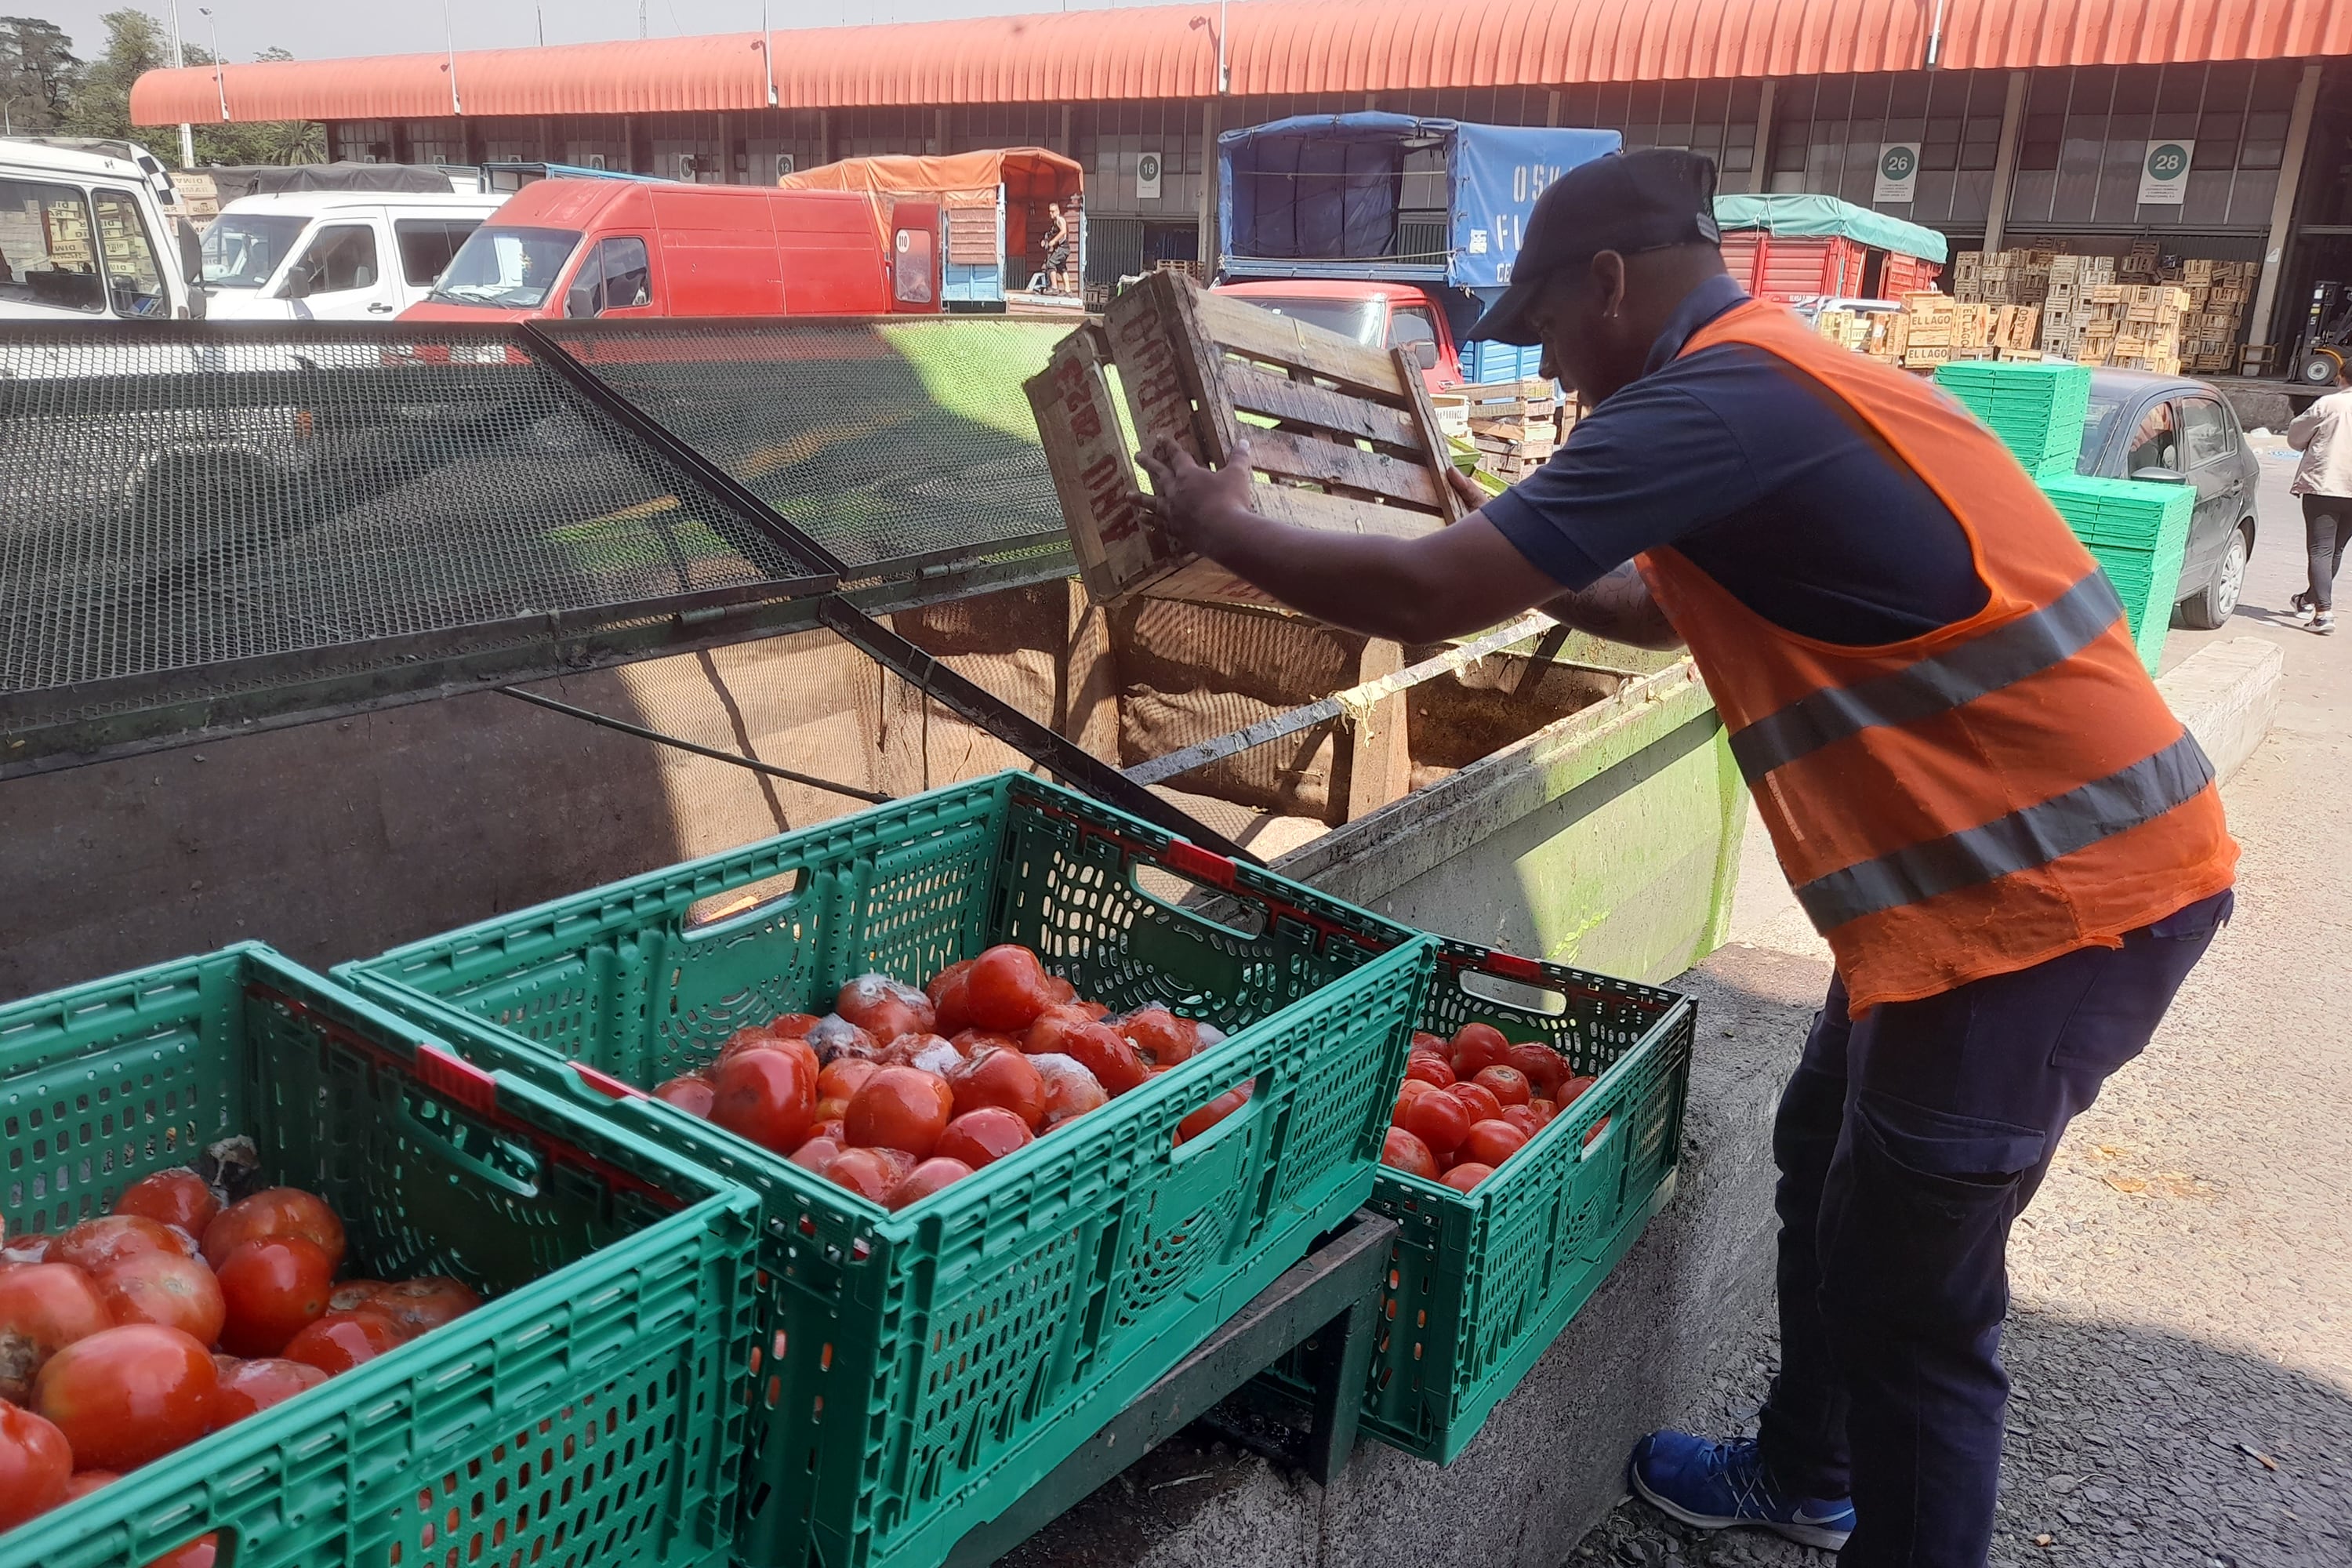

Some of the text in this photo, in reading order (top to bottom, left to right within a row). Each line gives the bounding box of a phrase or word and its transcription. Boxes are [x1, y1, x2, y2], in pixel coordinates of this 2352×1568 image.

[781, 162, 789, 172] 12
[1143, 162, 1155, 174] 18
[1887, 157, 1908, 170] 26
[2154, 155, 2180, 170] 28
[898, 235, 908, 248] 110
[1911, 315, 1951, 325] EL LAGO
[2014, 309, 2029, 334] LAGO
[1961, 308, 1973, 346] EL LAGO
[1908, 348, 1947, 359] EL LAGO
